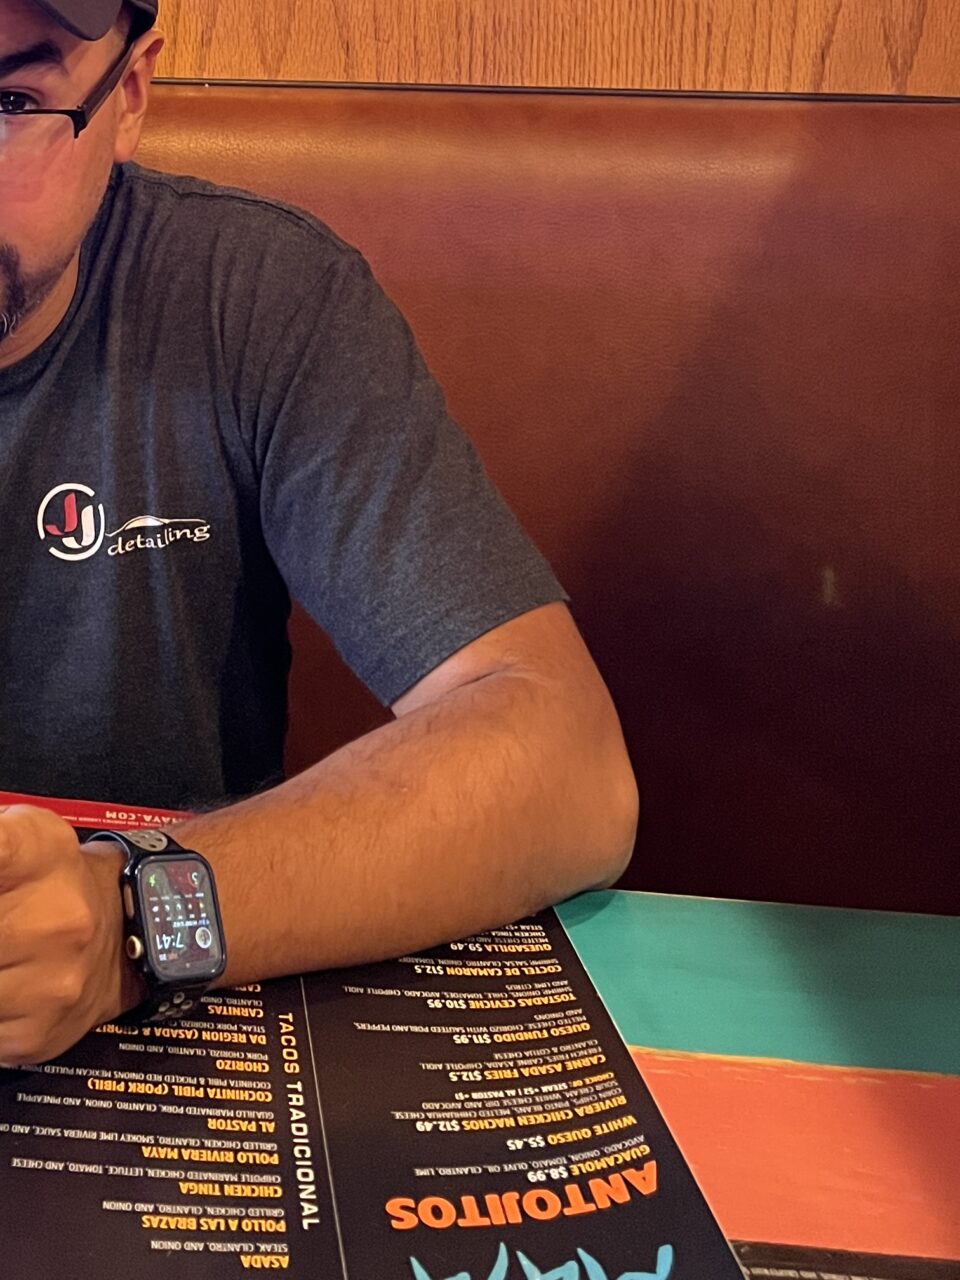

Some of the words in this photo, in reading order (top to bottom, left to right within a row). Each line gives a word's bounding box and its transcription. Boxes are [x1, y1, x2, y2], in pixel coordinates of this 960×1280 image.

[107, 524, 211, 556] detailing
[156, 932, 184, 949] 7:41
[518, 993, 576, 1007] TOSTADAS
[208, 1005, 264, 1018] CARNITAS
[154, 1027, 198, 1040] (ASADA
[493, 1030, 548, 1042] FUNDIDO
[550, 1022, 590, 1036] QUESO
[202, 1030, 247, 1043] REGION
[279, 1012, 299, 1073] TACOS
[216, 1060, 270, 1072] CHORIZO
[564, 1054, 606, 1070] CARNE
[520, 1063, 562, 1077] ASADA
[88, 1078, 124, 1093] PIBIL)
[127, 1082, 168, 1096] (PORK
[172, 1085, 204, 1098] PIBIL
[16, 1092, 60, 1105] PINEAPPLE
[206, 1088, 272, 1102] COCHINITA
[574, 1096, 627, 1117] RIVIERA
[208, 1118, 256, 1132] PASTOR
[462, 1117, 516, 1130] NACHOS
[517, 1110, 573, 1126] CHICKEN
[592, 1116, 637, 1136] WHITE
[506, 1136, 546, 1150] $5.45
[547, 1128, 592, 1144] QUESO
[141, 1146, 178, 1159] MAYA
[180, 1148, 234, 1162] RIVIERA
[236, 1152, 279, 1164] POLLO
[286, 1081, 320, 1230] TRADICIONAL
[570, 1144, 650, 1176] GUACAMOLE
[527, 1166, 568, 1182] $8.99
[178, 1182, 221, 1195] TINGA
[224, 1184, 282, 1198] CHICKEN
[385, 1161, 657, 1230] ANTOJITOS
[142, 1215, 196, 1230] BRAZAS
[200, 1218, 225, 1230] LAS
[228, 1219, 238, 1231] A
[242, 1219, 286, 1232] POLLO
[240, 1255, 289, 1268] ASADA
